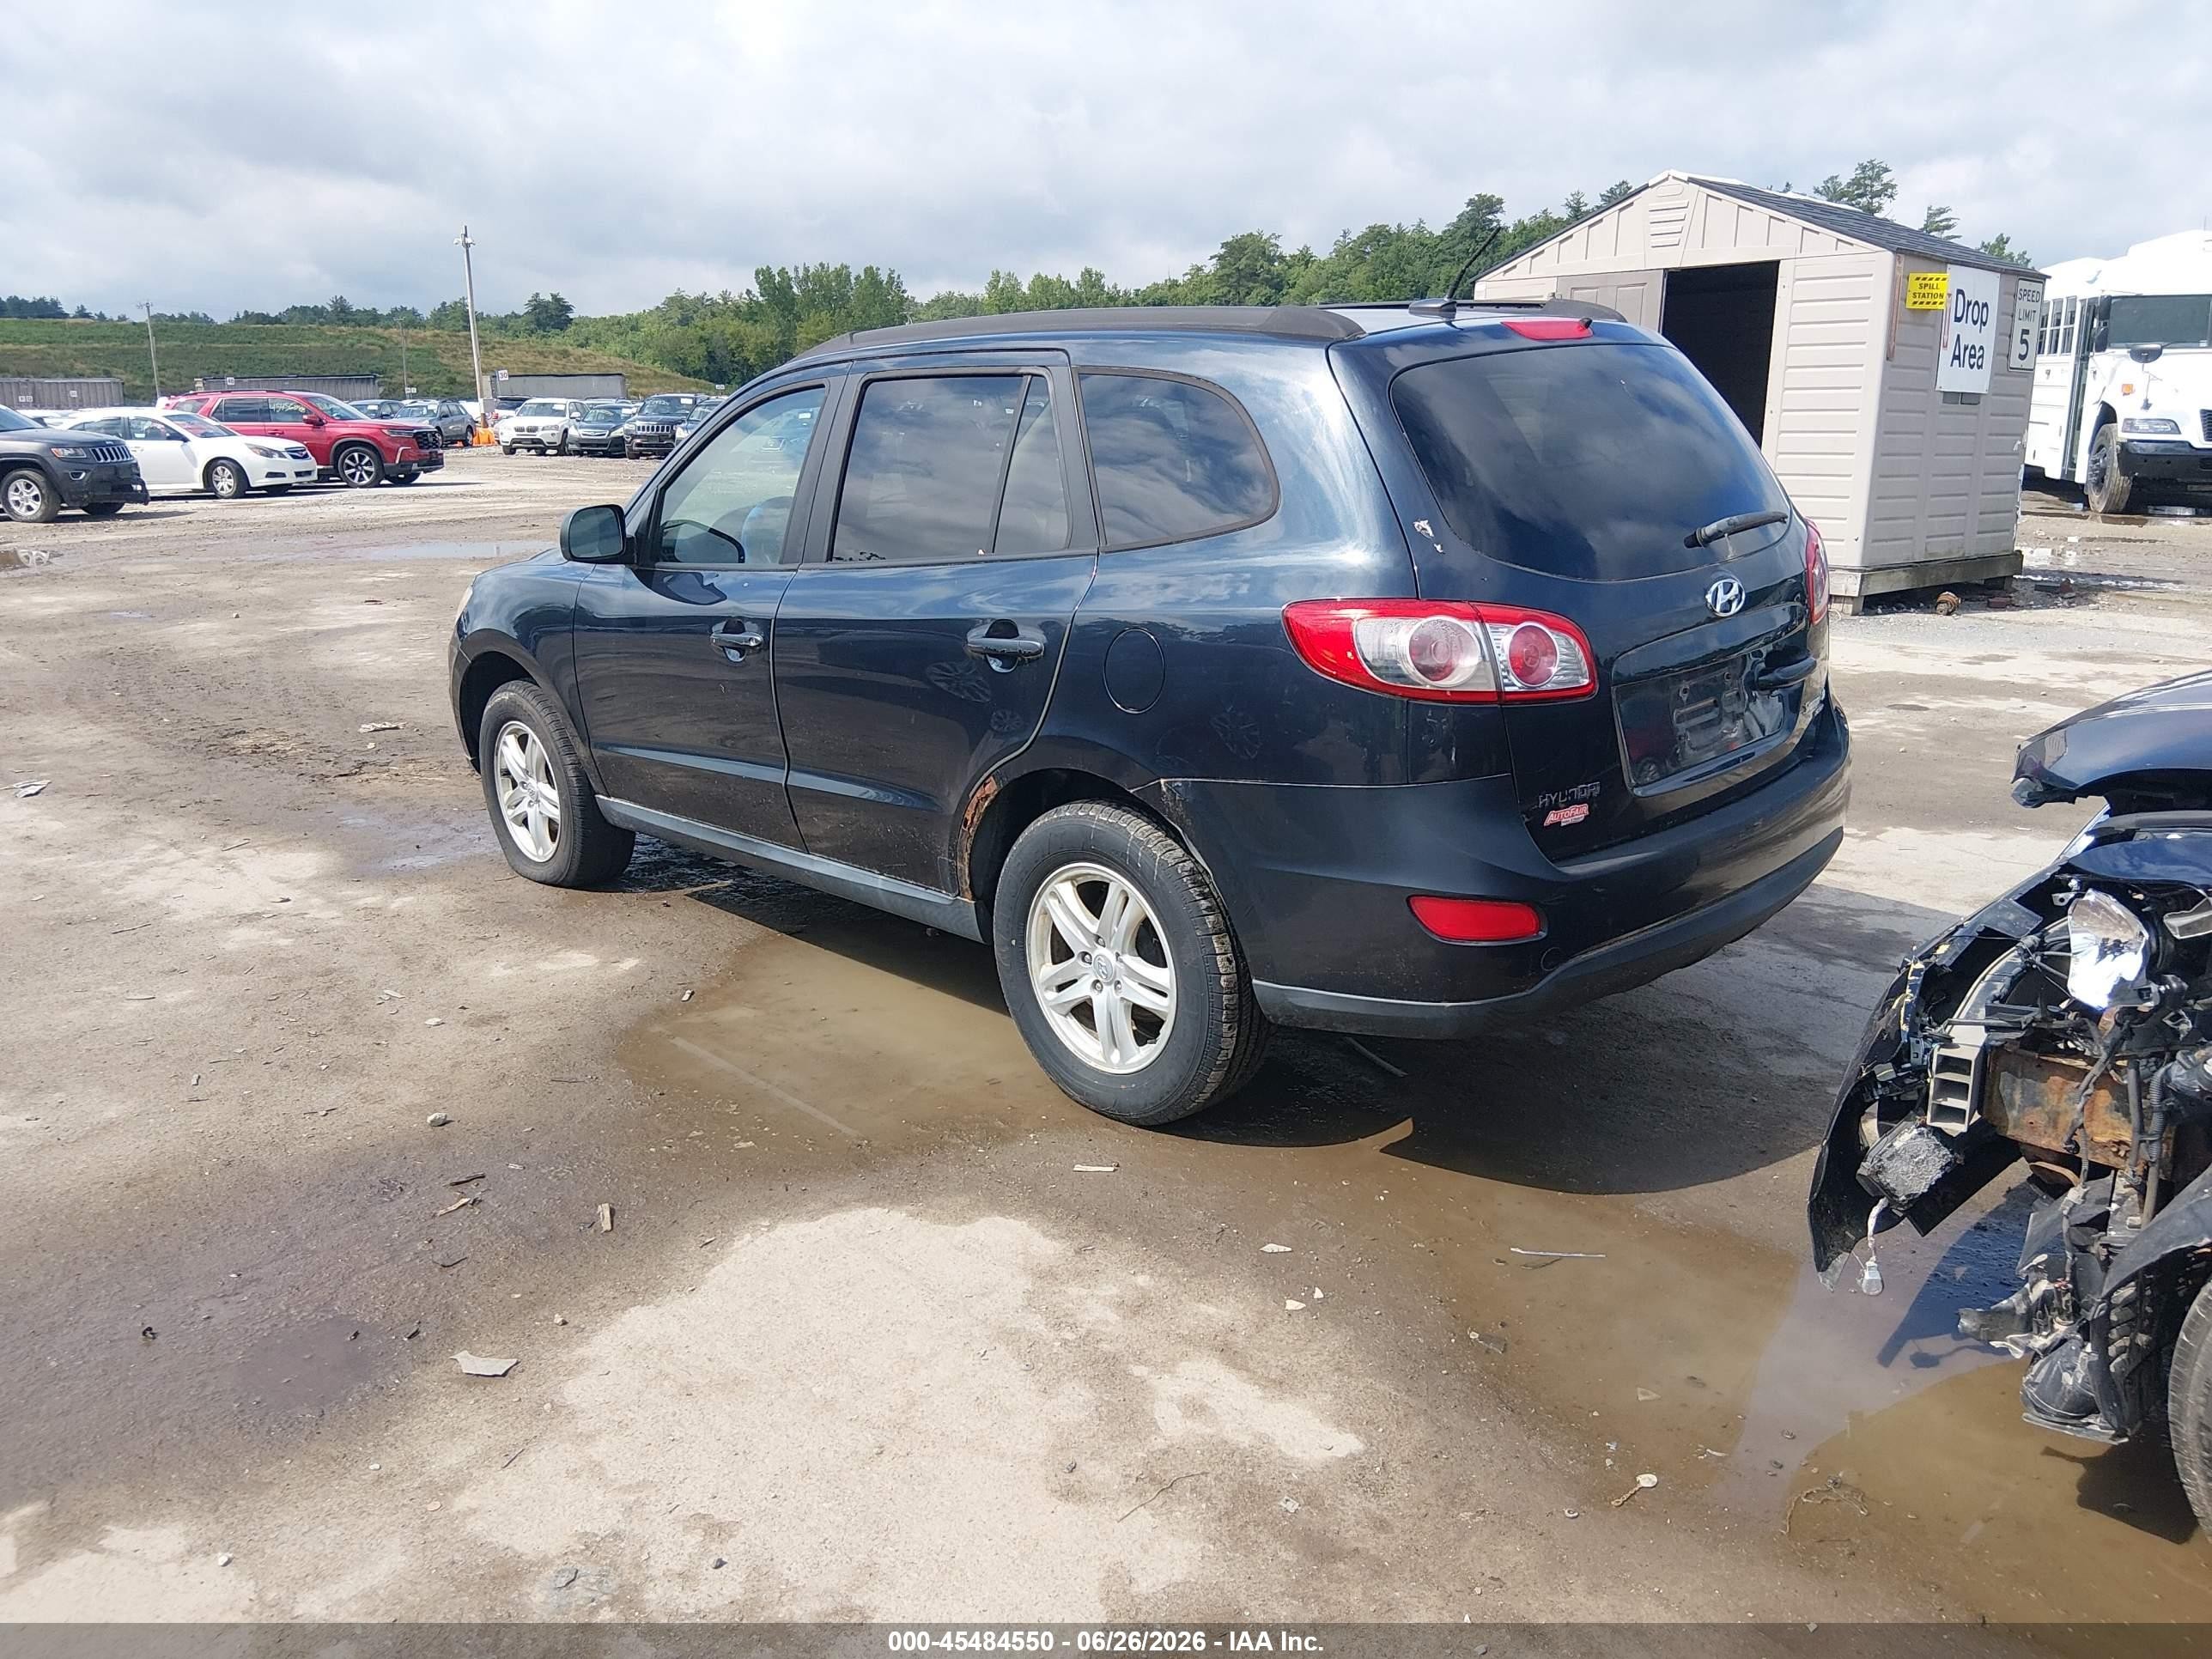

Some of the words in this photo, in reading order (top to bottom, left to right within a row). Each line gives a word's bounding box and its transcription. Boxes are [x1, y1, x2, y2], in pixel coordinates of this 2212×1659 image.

[2018, 288, 2041, 303] SPEED
[1954, 289, 1990, 333] Drop
[2018, 308, 2037, 323] LIMIT
[1950, 333, 1985, 370] Area
[2018, 329, 2030, 361] 5
[1546, 805, 1588, 823] AUTOFAIR
